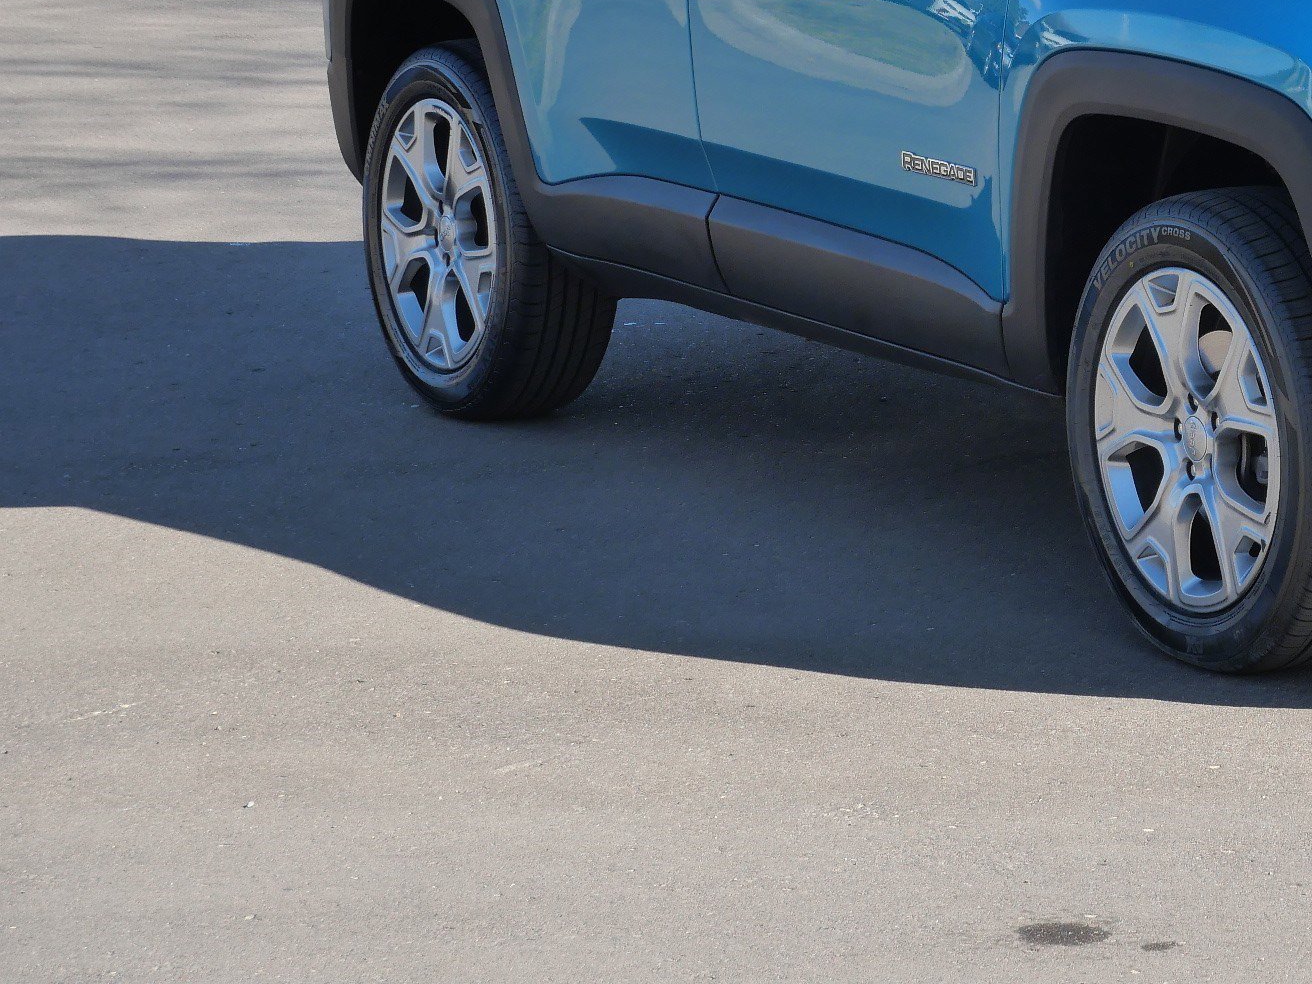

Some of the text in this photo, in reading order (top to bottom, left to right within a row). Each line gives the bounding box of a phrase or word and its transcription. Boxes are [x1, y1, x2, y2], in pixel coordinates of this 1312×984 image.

[901, 150, 977, 187] RENEGADE
[1093, 226, 1192, 291] VELOCITY CROSS
